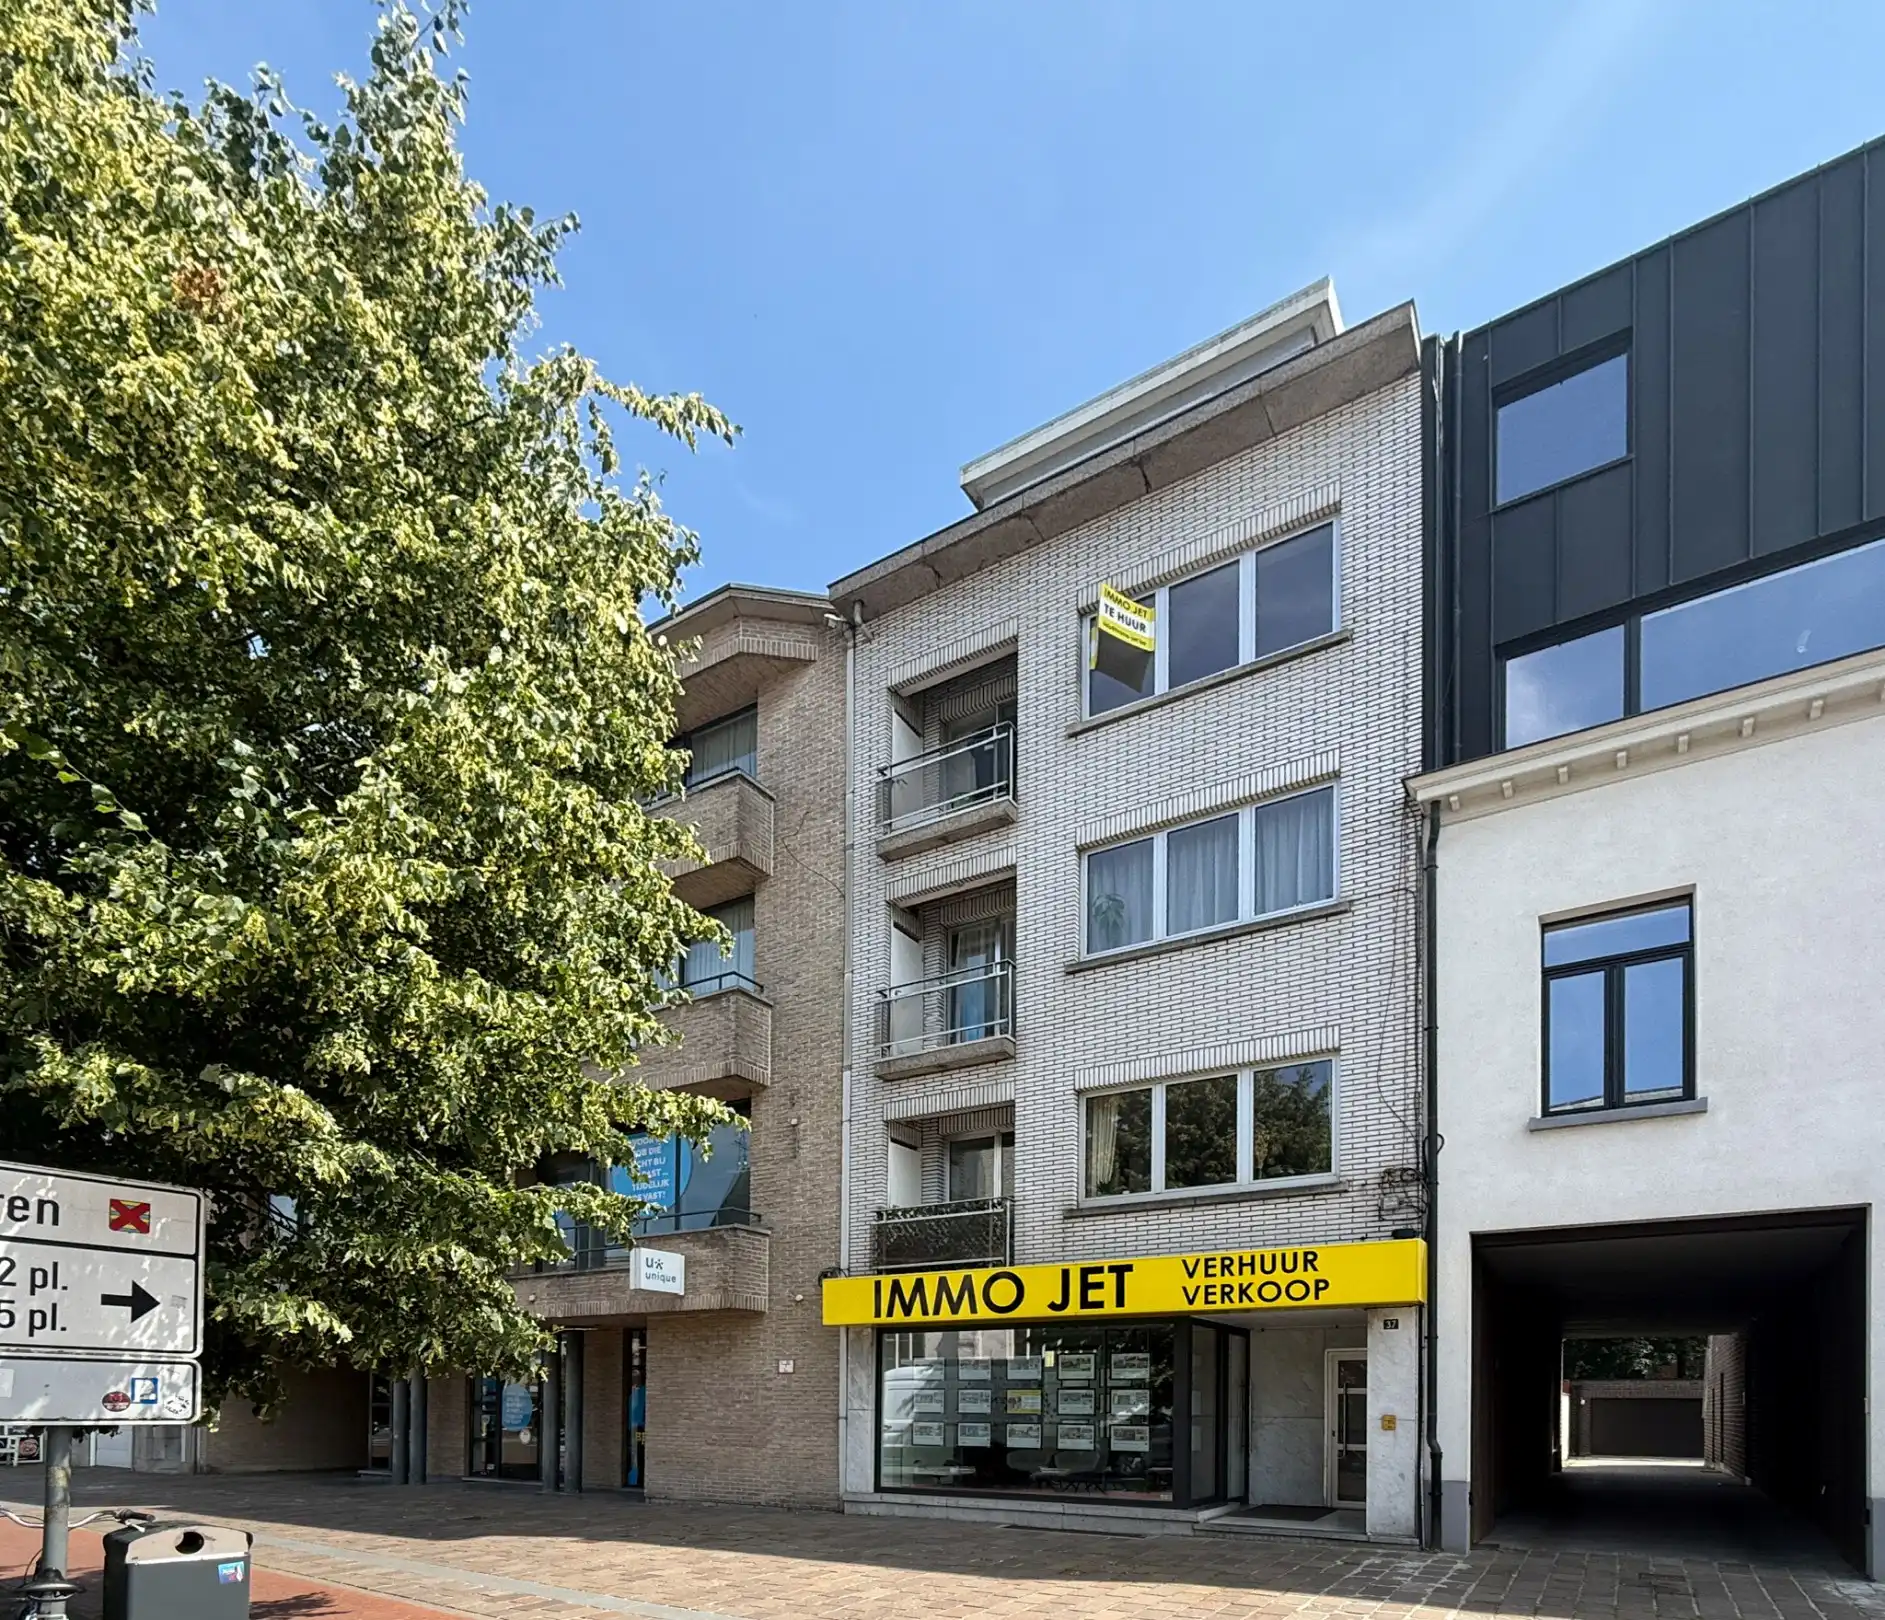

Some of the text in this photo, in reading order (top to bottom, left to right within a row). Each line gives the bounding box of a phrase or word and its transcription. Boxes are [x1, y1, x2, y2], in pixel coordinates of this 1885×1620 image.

[1104, 588, 1147, 618] IMMO JET
[1104, 603, 1115, 618] TE
[1117, 611, 1147, 633] HUUR
[649, 1146, 661, 1154] DIE
[654, 1157, 666, 1166] BIJ
[632, 1179, 669, 1191] TIJDELIJK
[0, 1194, 60, 1226] en
[29, 1261, 69, 1296] pl.
[645, 1272, 676, 1283] unique
[1181, 1251, 1319, 1279] VERHUUR
[874, 1263, 1134, 1319] IMMO JET
[1181, 1278, 1330, 1306] VERKOOP
[28, 1302, 67, 1337] pl.
[1385, 1320, 1397, 1329] 37
